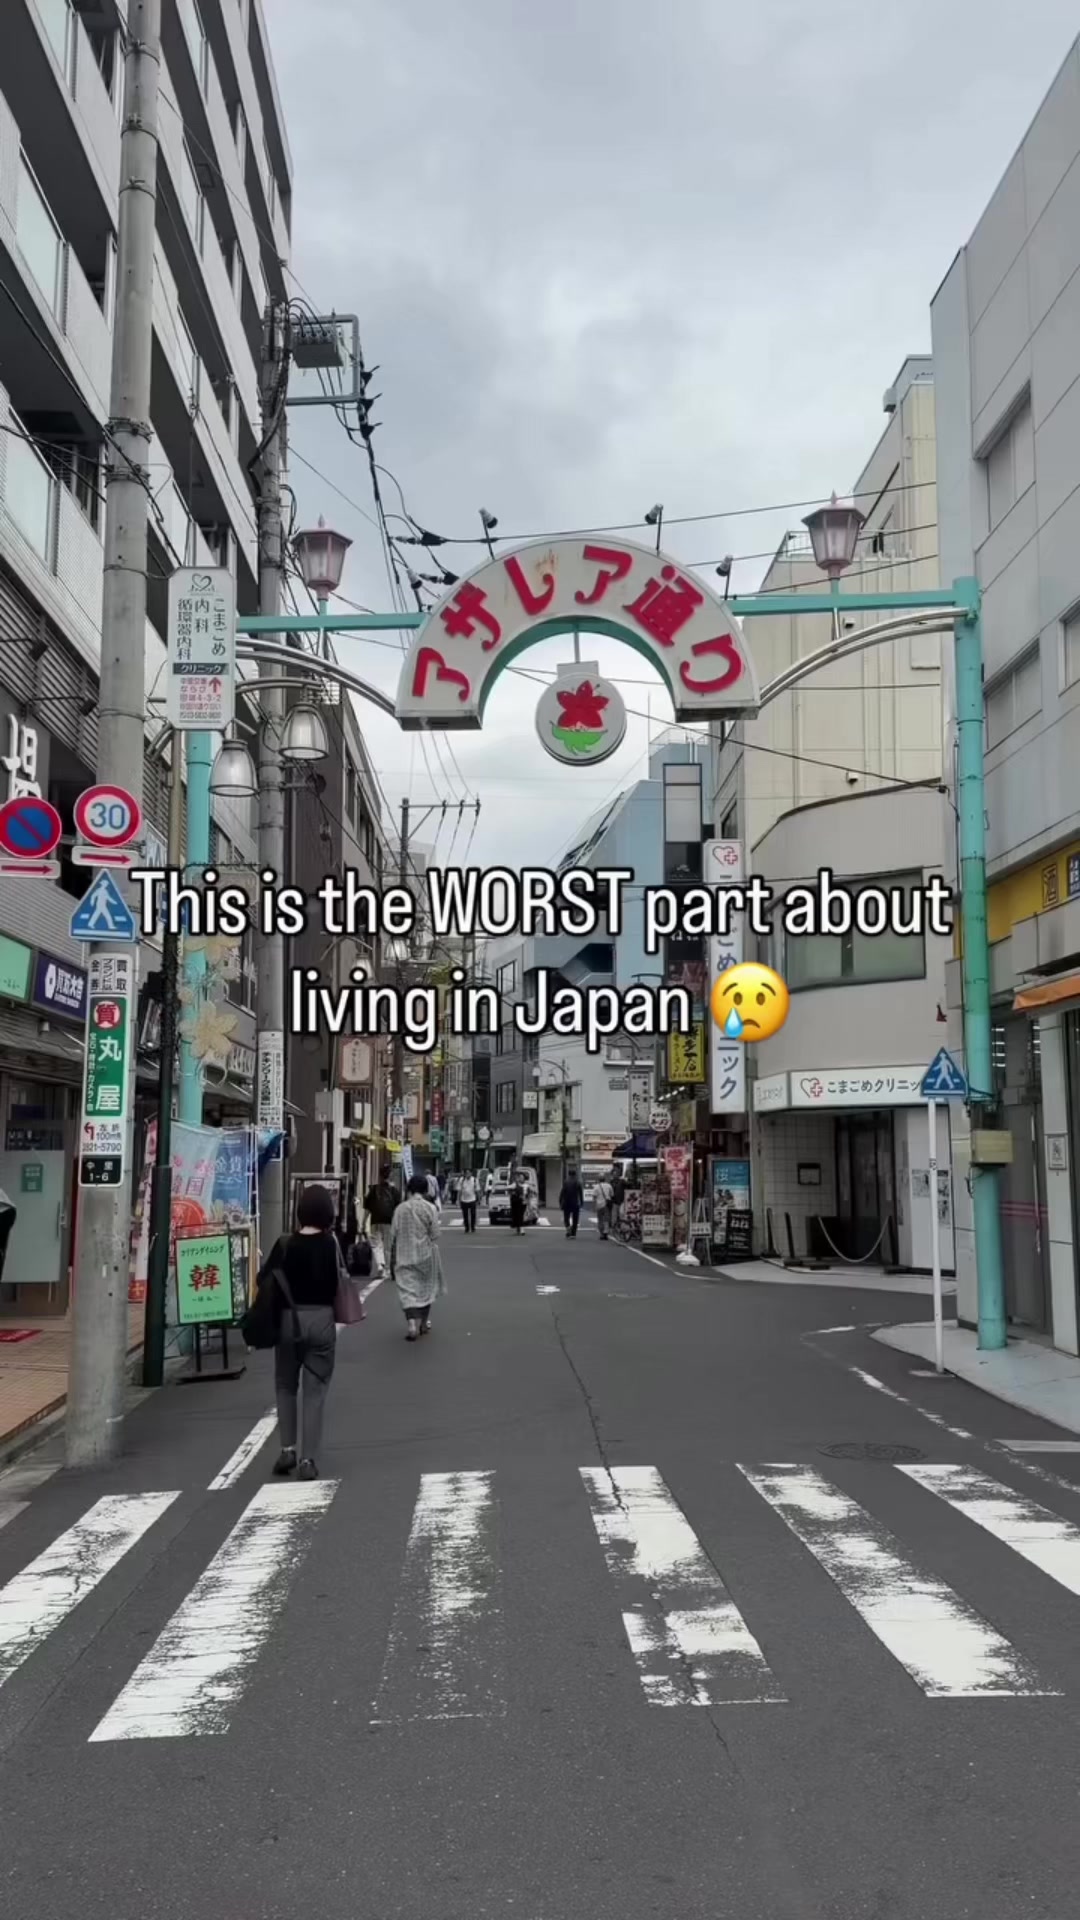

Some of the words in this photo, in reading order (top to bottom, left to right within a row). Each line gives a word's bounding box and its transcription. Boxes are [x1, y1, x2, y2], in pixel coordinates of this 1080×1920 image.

[177, 598, 192, 660] 循環器内科
[194, 598, 209, 633] 内科
[211, 598, 226, 656] こまごめ
[411, 545, 743, 704] アザレア通り
[181, 664, 221, 674] クリニック
[90, 802, 126, 830] 30
[117, 959, 128, 991] 買取
[95, 1036, 122, 1111] 丸屋
[827, 1077, 922, 1094] こまごめクリニッ
[89, 1172, 109, 1181] 1-6
[188, 1263, 221, 1292] 韓
